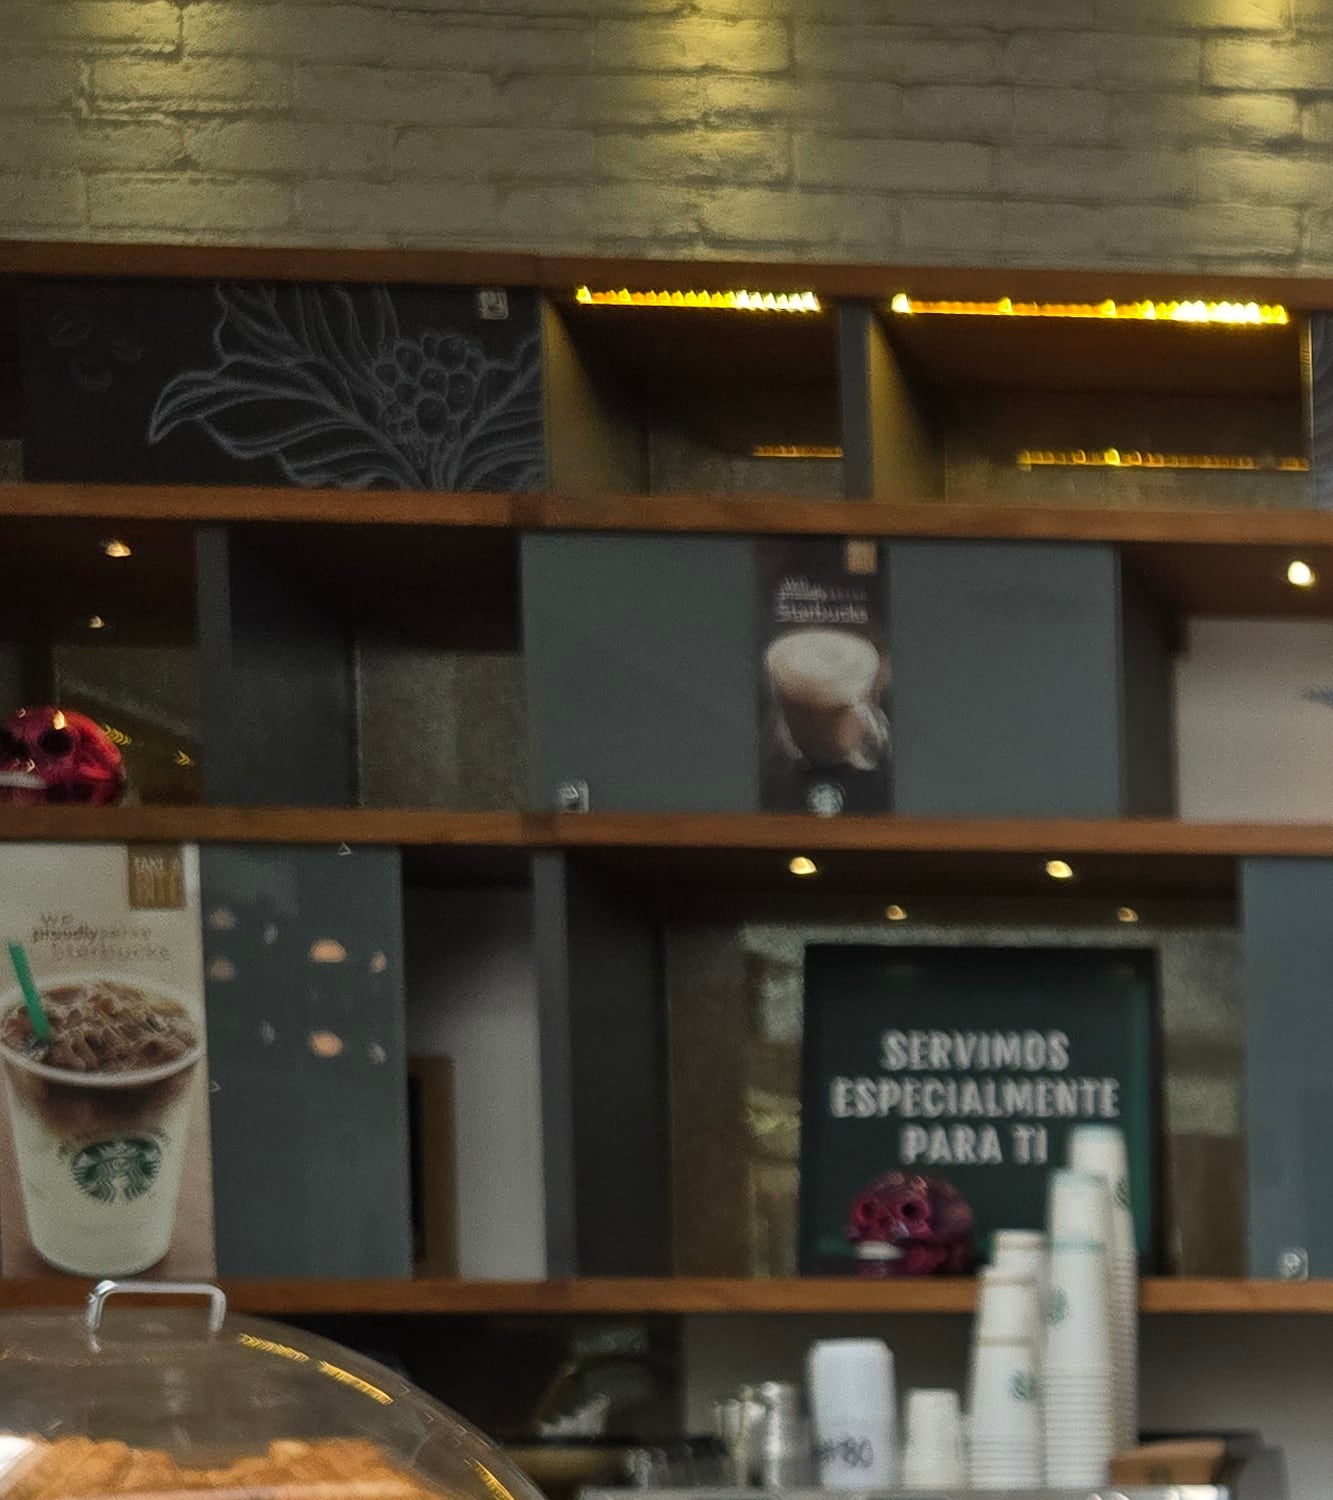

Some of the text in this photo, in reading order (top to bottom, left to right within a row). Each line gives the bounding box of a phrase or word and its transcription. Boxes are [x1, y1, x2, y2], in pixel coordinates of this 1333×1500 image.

[880, 1029, 1069, 1071] SERVIMOS
[829, 1077, 1120, 1118] ESPECIALMENTE
[899, 1124, 1048, 1164] PARA TI
